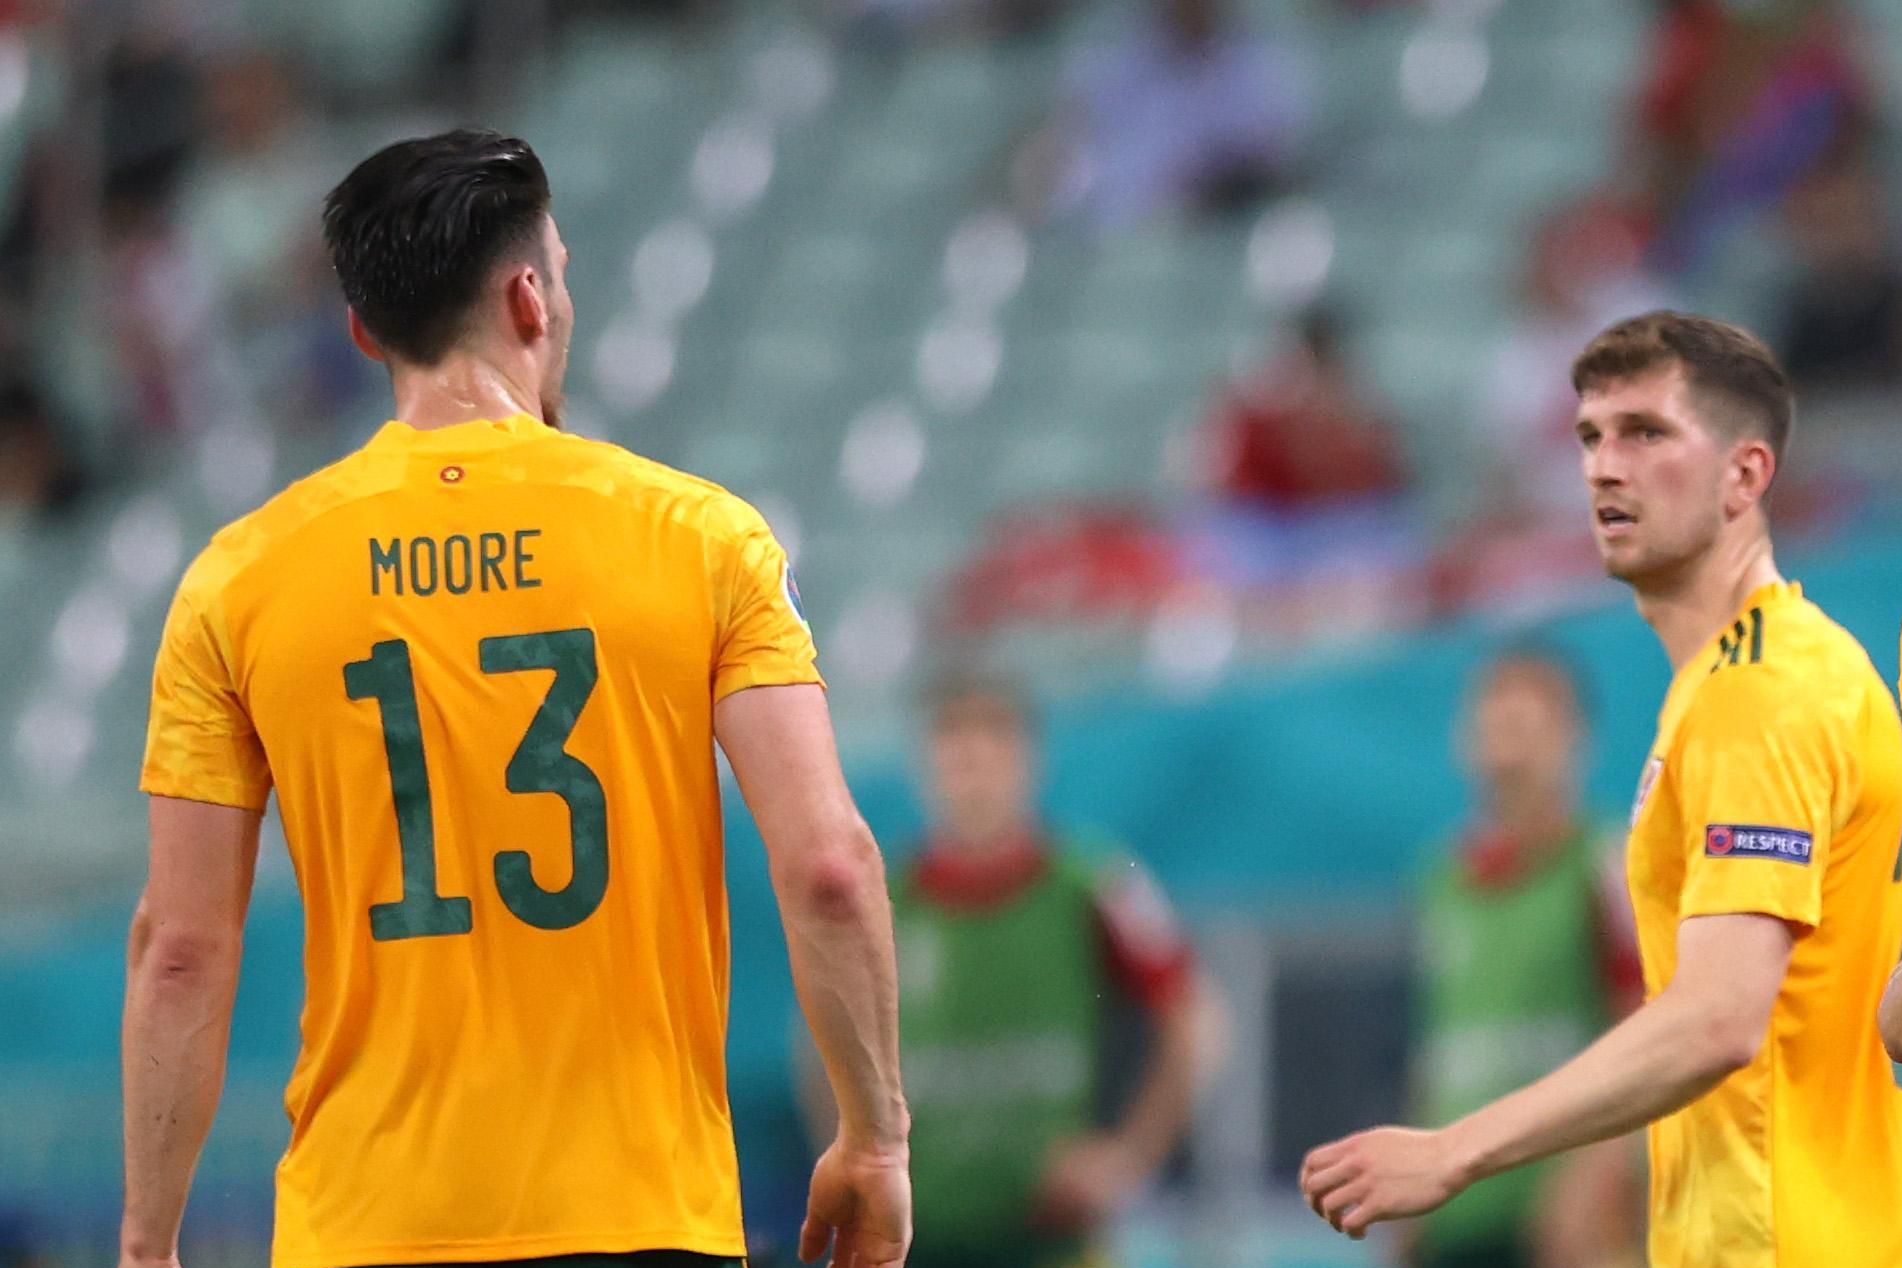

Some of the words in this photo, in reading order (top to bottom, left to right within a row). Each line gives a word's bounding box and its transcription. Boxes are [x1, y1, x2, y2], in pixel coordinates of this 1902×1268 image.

[370, 529, 543, 596] MOORE
[343, 628, 609, 942] 13
[1733, 831, 1810, 857] RESPECT
